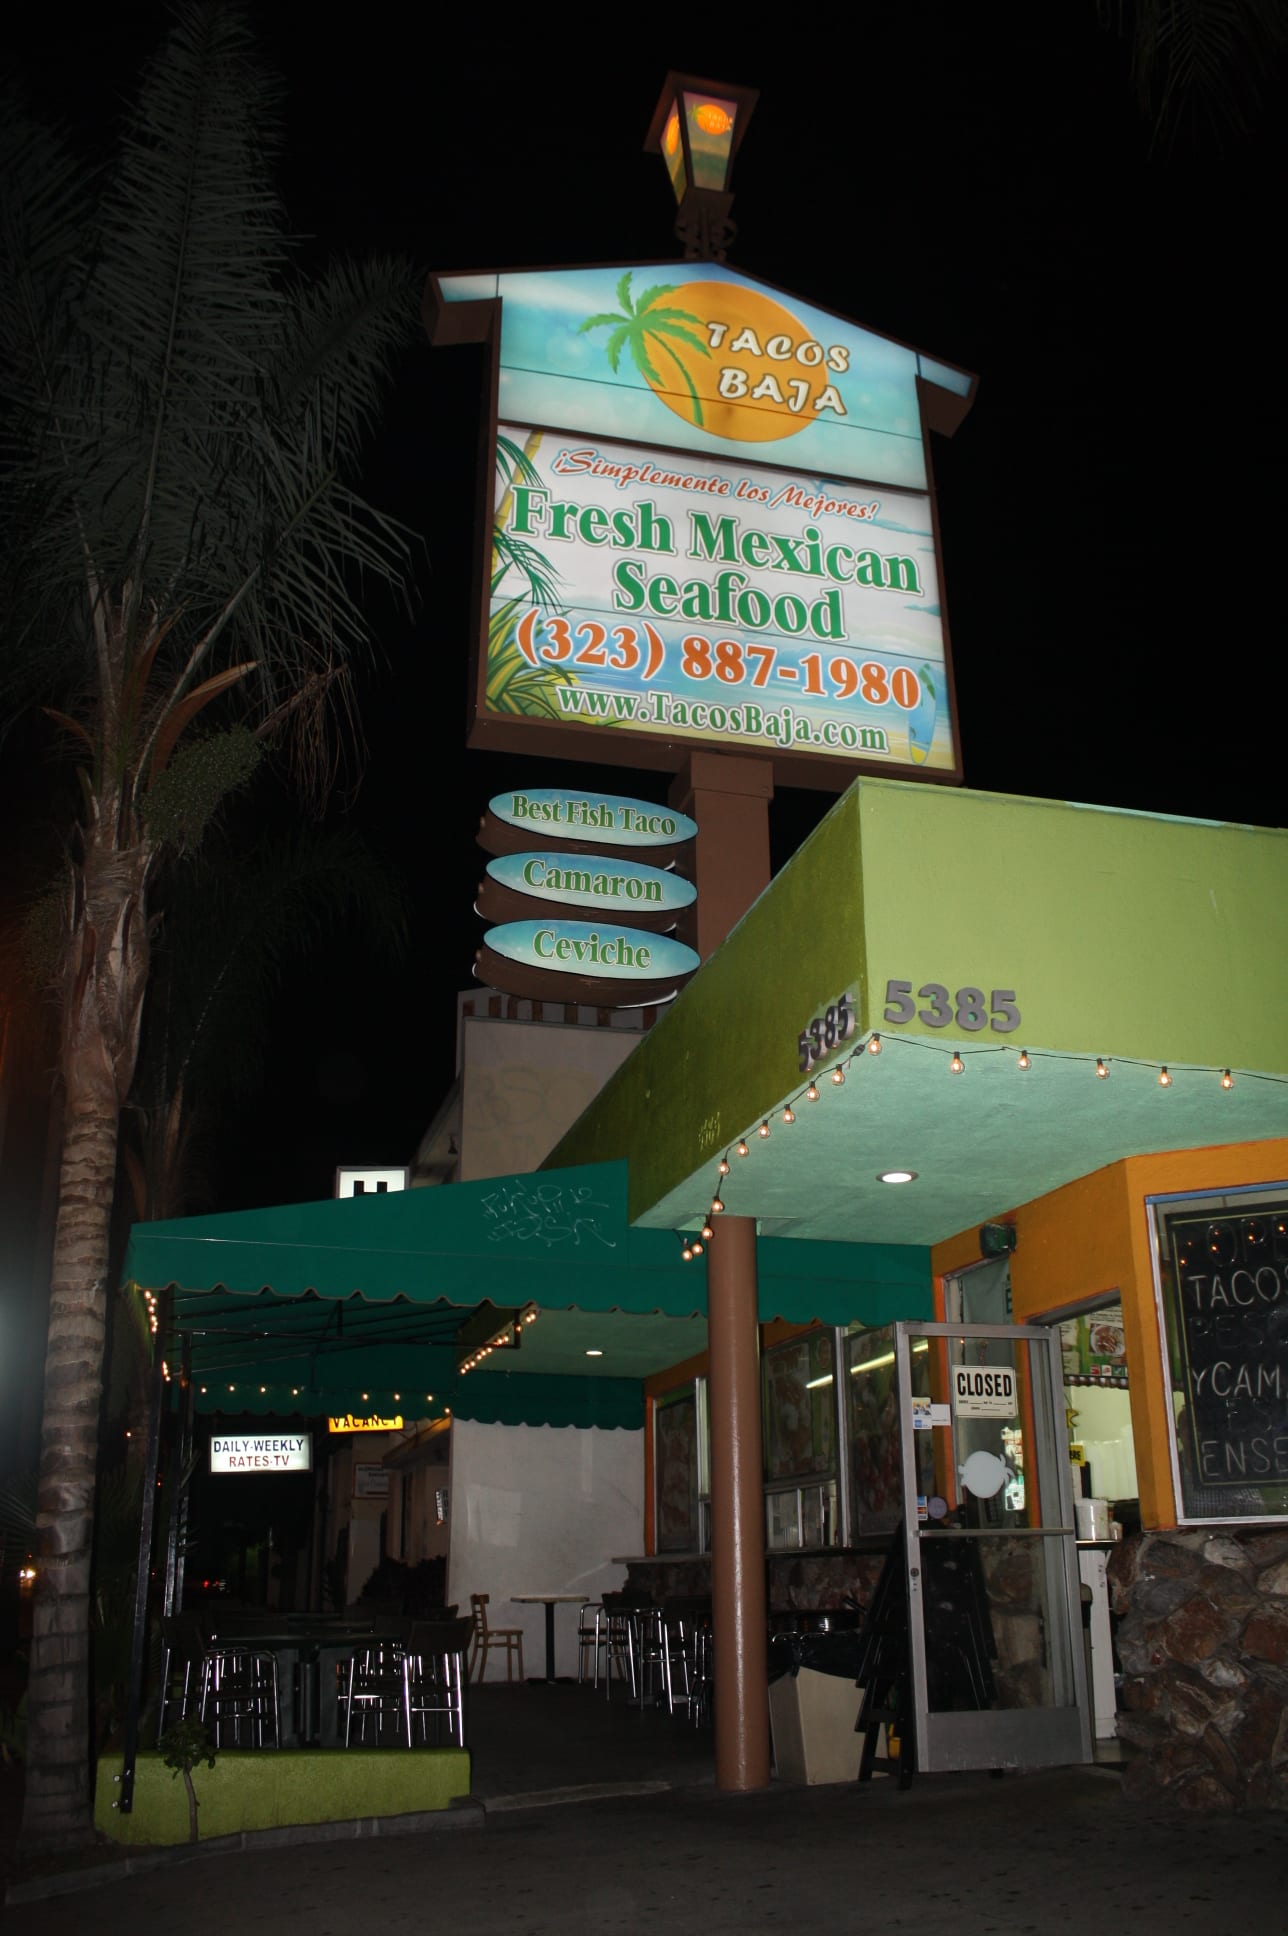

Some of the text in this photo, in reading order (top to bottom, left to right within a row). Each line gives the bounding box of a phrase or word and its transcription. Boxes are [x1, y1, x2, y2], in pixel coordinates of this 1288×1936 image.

[707, 321, 851, 373] TACOS
[718, 366, 848, 416] BAJA
[736, 480, 770, 504] los
[770, 486, 880, 522] Mejores!
[510, 484, 923, 595] Fresh Mexican
[614, 560, 847, 640] Seafood
[517, 608, 921, 710] (323) 887-1980
[556, 686, 889, 754] www.TacosBaja.com
[512, 795, 677, 837] Best Fish Taco
[523, 860, 664, 903] Camaron
[533, 930, 651, 969] Ceviche
[799, 991, 856, 1073] 5385
[884, 979, 1022, 1034] 5385
[957, 1372, 1012, 1397] CLOSED
